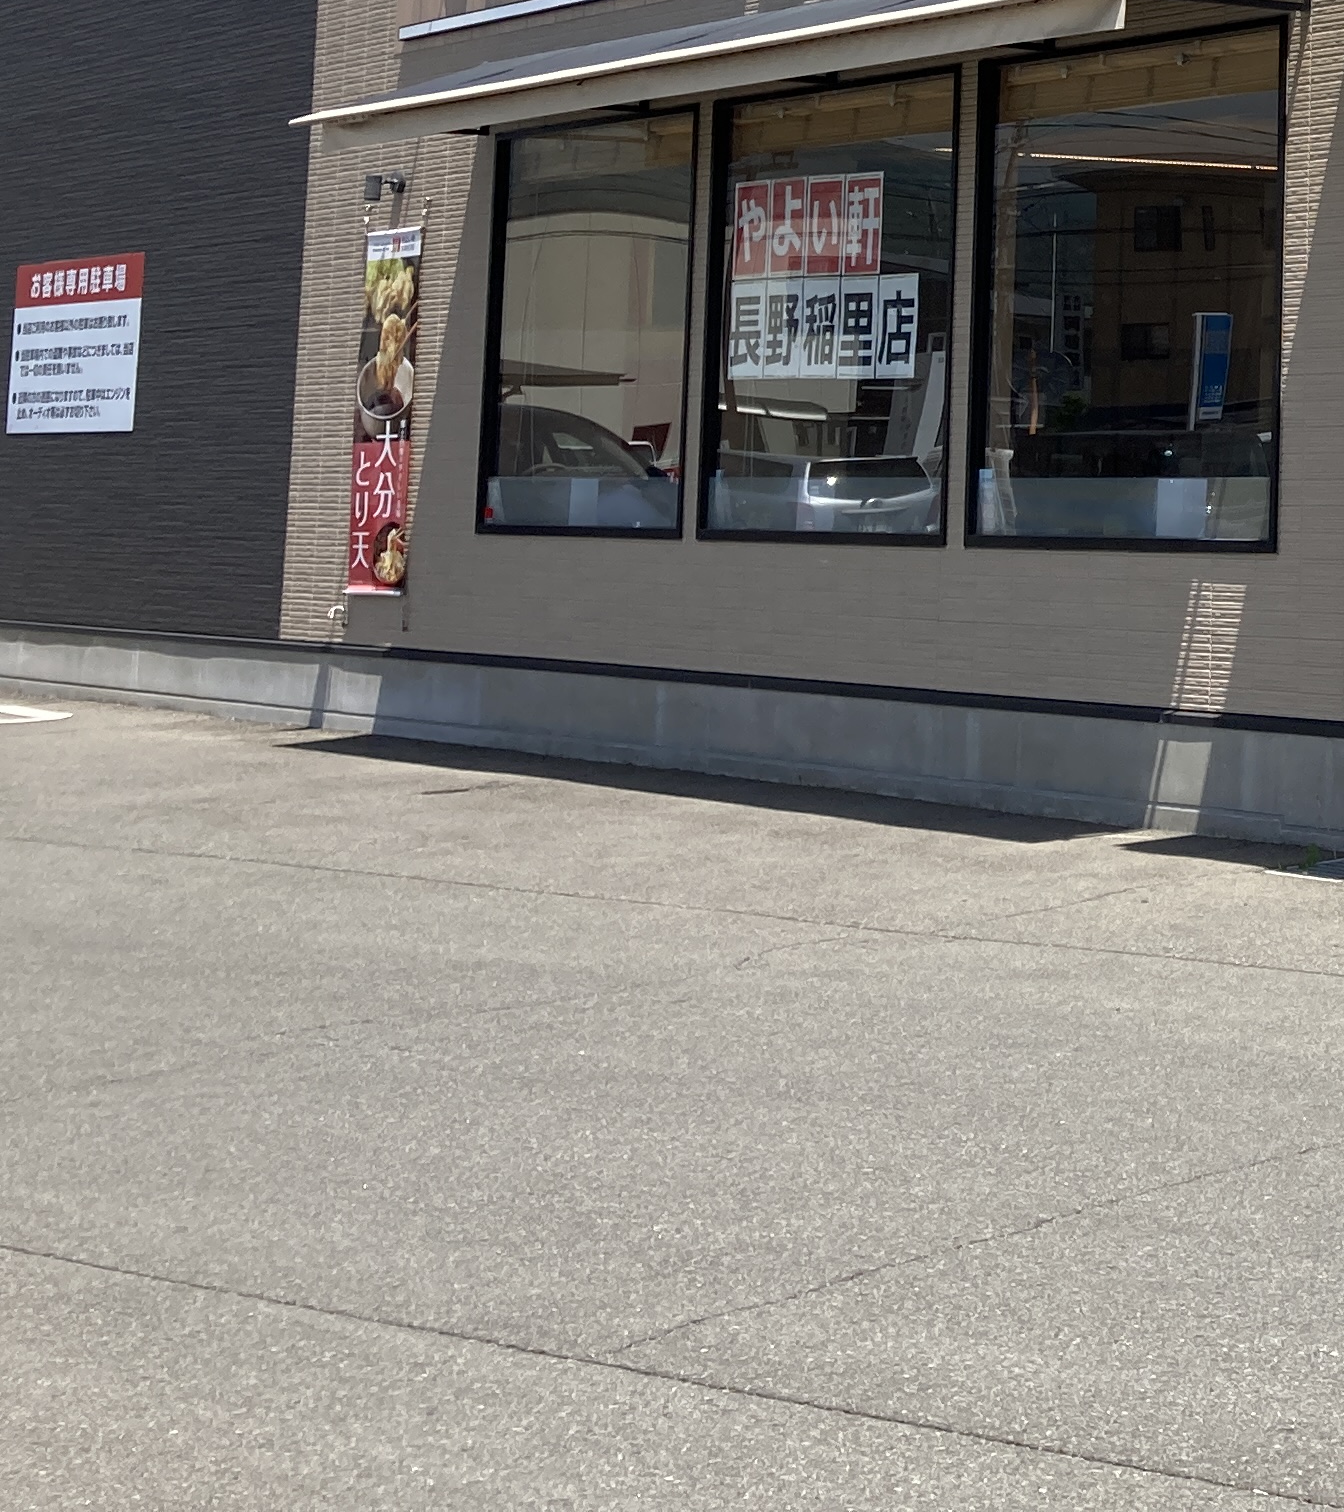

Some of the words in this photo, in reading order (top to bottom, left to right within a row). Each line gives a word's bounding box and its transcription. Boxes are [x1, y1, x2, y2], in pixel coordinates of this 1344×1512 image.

[738, 185, 880, 267] やよい軒
[30, 264, 127, 298] お客様専用駐車場
[730, 290, 915, 367] 長野稲里店
[351, 451, 370, 569] とり天
[373, 421, 398, 519] 大分
